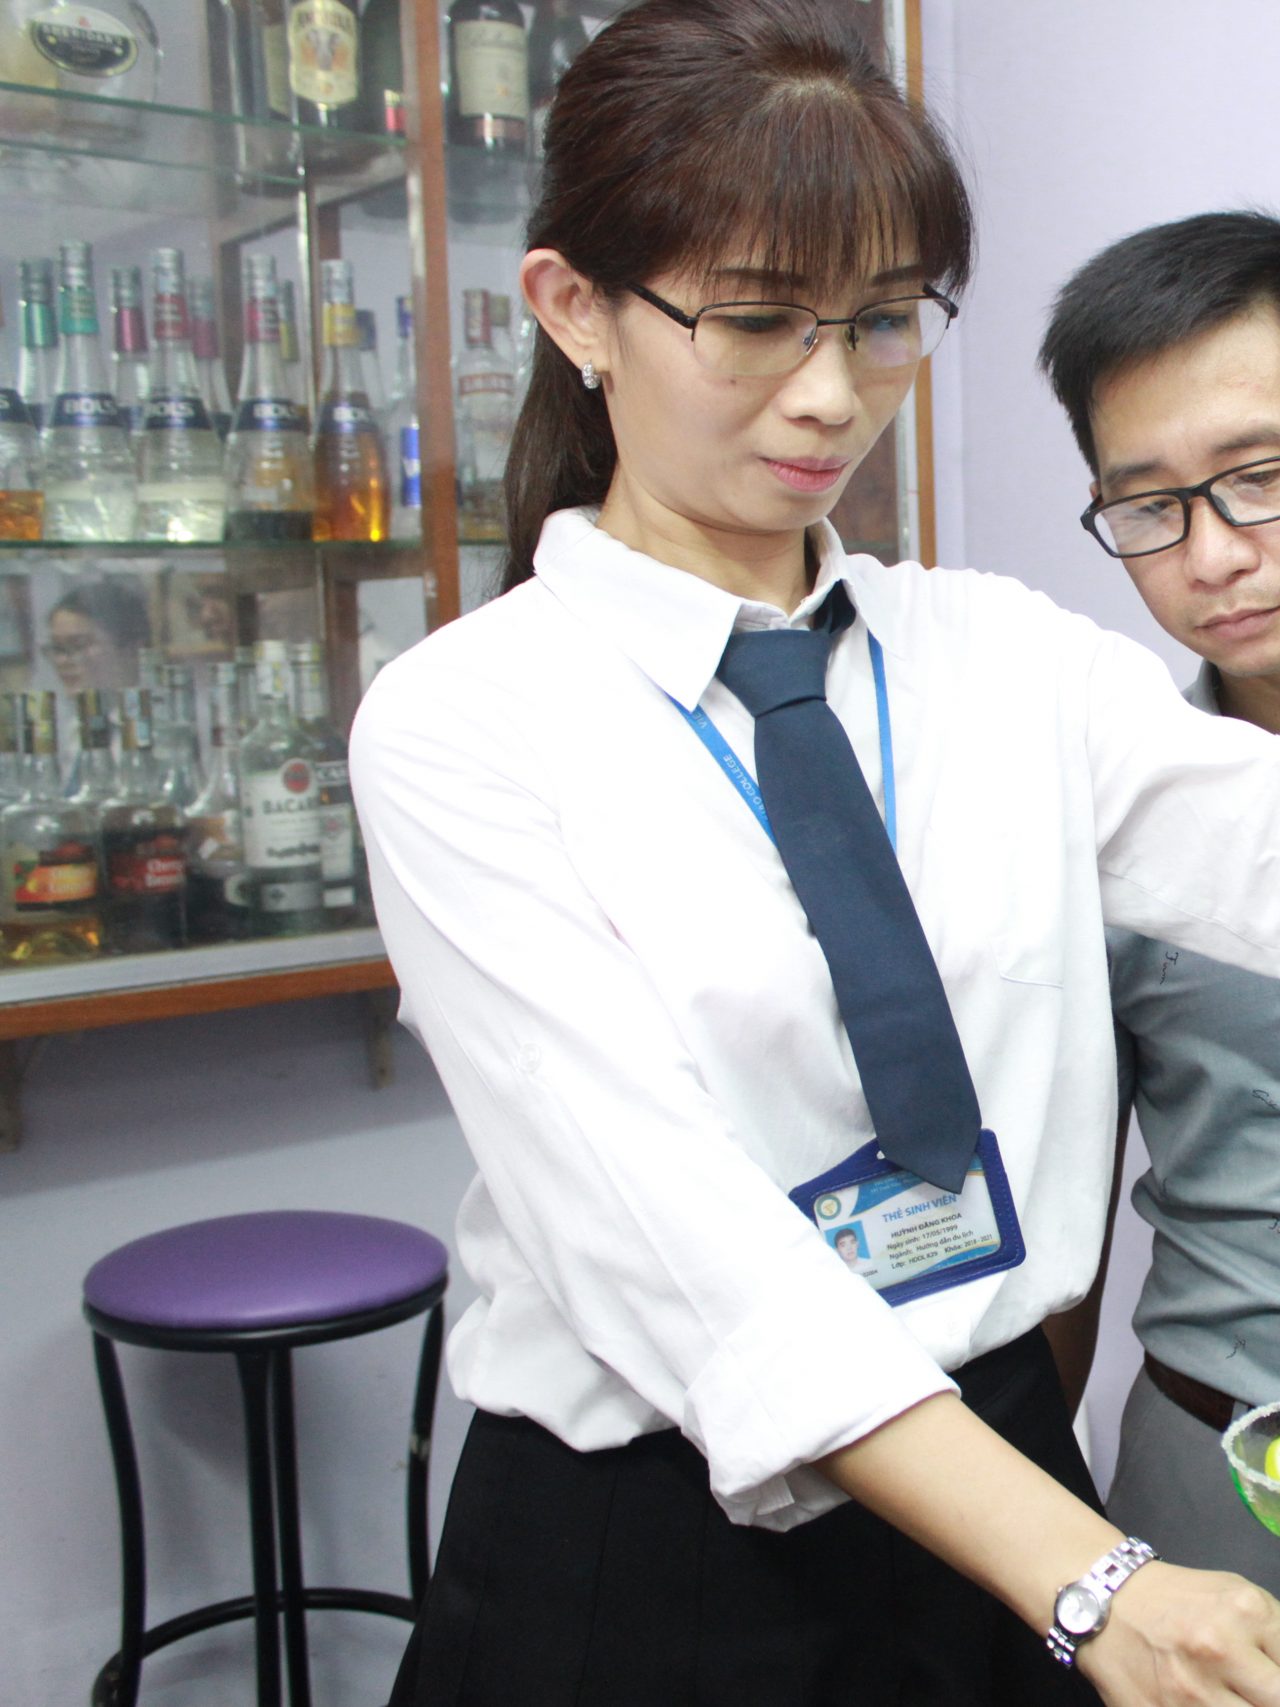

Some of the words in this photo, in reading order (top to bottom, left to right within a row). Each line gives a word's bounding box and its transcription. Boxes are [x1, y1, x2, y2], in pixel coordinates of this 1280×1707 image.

[723, 753, 756, 797] COLLEGE
[882, 1208, 904, 1223] THẺ
[905, 1201, 931, 1217] SINH
[941, 1212, 962, 1223] KHOA
